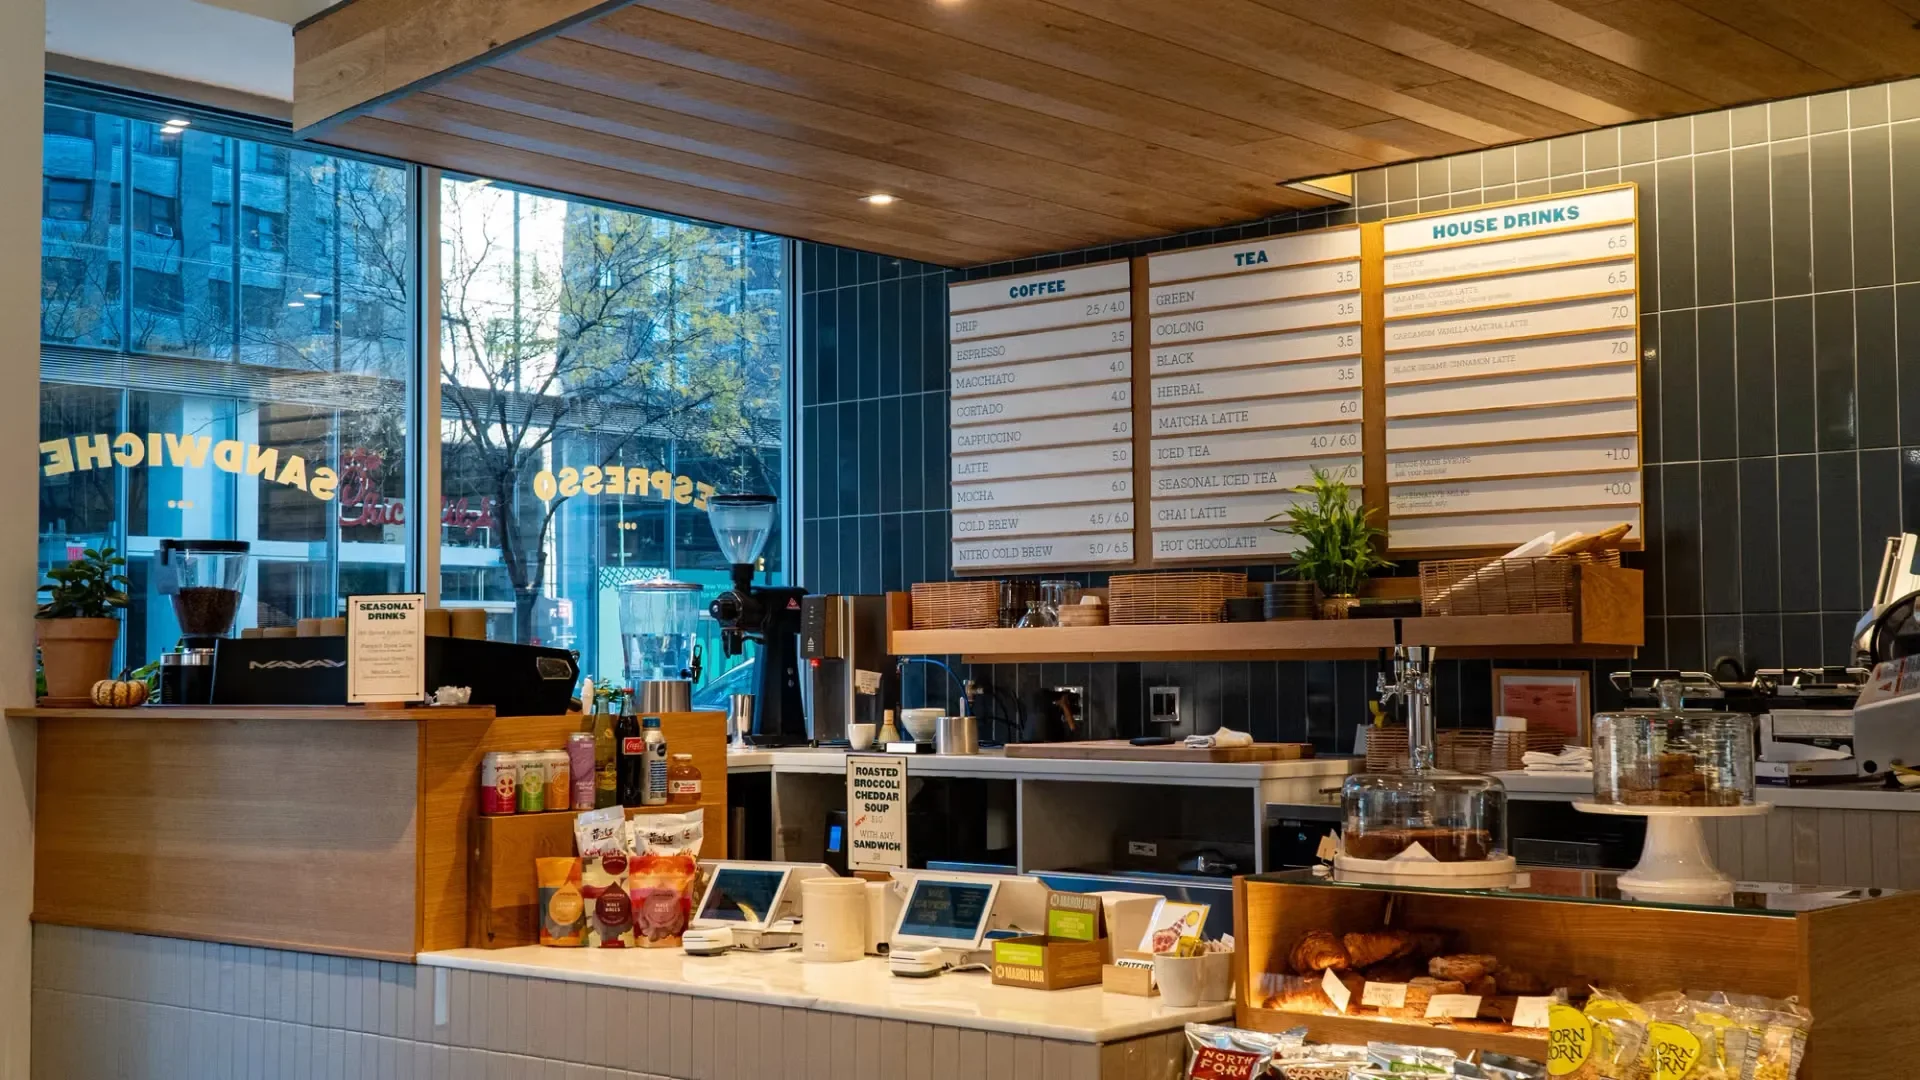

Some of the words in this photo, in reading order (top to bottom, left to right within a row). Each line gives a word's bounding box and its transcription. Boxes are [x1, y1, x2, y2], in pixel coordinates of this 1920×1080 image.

[1433, 217, 1498, 239] HOUSE
[1504, 206, 1580, 229] DRINKS
[1608, 236, 1627, 249] 6.5
[1234, 250, 1268, 266] TEA
[1337, 271, 1353, 283] 3.5
[1608, 271, 1627, 284] 6.5
[1009, 280, 1066, 298] COFFEE
[1156, 291, 1195, 306] GREEN
[1110, 300, 1125, 312] 4.0
[1338, 303, 1354, 315] 3.5
[1611, 306, 1628, 319] 7.0
[955, 320, 979, 333] DRIP
[1156, 321, 1204, 336] OOLONG
[1112, 331, 1124, 342] 3.5
[1337, 335, 1354, 348] 3.5
[956, 345, 1006, 361] ESPRESSO
[1611, 342, 1628, 354] 7.0
[1110, 361, 1124, 372] 4.0
[1156, 352, 1194, 367] BLACK
[955, 372, 1016, 389] MACCHIATO
[1338, 368, 1354, 381] 3.5
[1111, 390, 1126, 401] 4.0
[1157, 383, 1204, 398] HERBAL
[956, 403, 1004, 418] CORTADO
[1158, 414, 1208, 429] MATCHA
[1211, 410, 1249, 425] LATTE
[1340, 401, 1357, 414] 6.0
[957, 430, 1022, 447] CAPPUCCINO
[1112, 421, 1127, 433] 4.0
[1158, 446, 1185, 460] ICED
[1187, 444, 1211, 457] TEA
[1310, 436, 1327, 448] 4.0
[1330, 436, 1337, 446] /
[1340, 434, 1356, 446] 6.0
[1605, 447, 1630, 460] +1.0
[958, 461, 989, 474] LATTE
[1112, 450, 1127, 462] 5.0
[1158, 475, 1219, 490] SEASONAL
[1222, 473, 1250, 486] ICED
[1253, 471, 1278, 484] TEA
[957, 490, 994, 503] MOCHA
[1112, 480, 1126, 492] 6.0
[1603, 482, 1632, 496] +0.0
[1158, 508, 1187, 521] CHAI
[1190, 506, 1227, 519] LATTE
[958, 520, 985, 532] COLD
[988, 518, 1019, 530] BREW
[1090, 513, 1104, 525] 4.5
[1114, 512, 1129, 523] 6.0
[1160, 538, 1184, 552] HOT
[1186, 536, 1257, 551] CHOCOLATE
[959, 548, 990, 561] NITRO
[992, 546, 1019, 559] COLD
[1022, 545, 1053, 558] BREW
[1089, 543, 1104, 554] 5.0
[1114, 542, 1129, 553] 6.5
[368, 612, 406, 620] DRINKS
[856, 766, 898, 777] ROASTED
[854, 778, 900, 790] BROCCOLI
[855, 790, 900, 802] CHEDDAR
[864, 803, 890, 813] SOUP
[860, 830, 878, 839] WITH
[880, 831, 895, 840] ANY
[854, 840, 901, 851] SANDWICH
[1118, 960, 1154, 971] SPITFIRE
[1030, 969, 1044, 983] BAR
[1204, 1050, 1254, 1065] NORTH
[1548, 1044, 1583, 1063] ORN
[1653, 1042, 1695, 1061] ORN
[1200, 1059, 1249, 1077] FORK
[1286, 1068, 1344, 1078] NORTH
